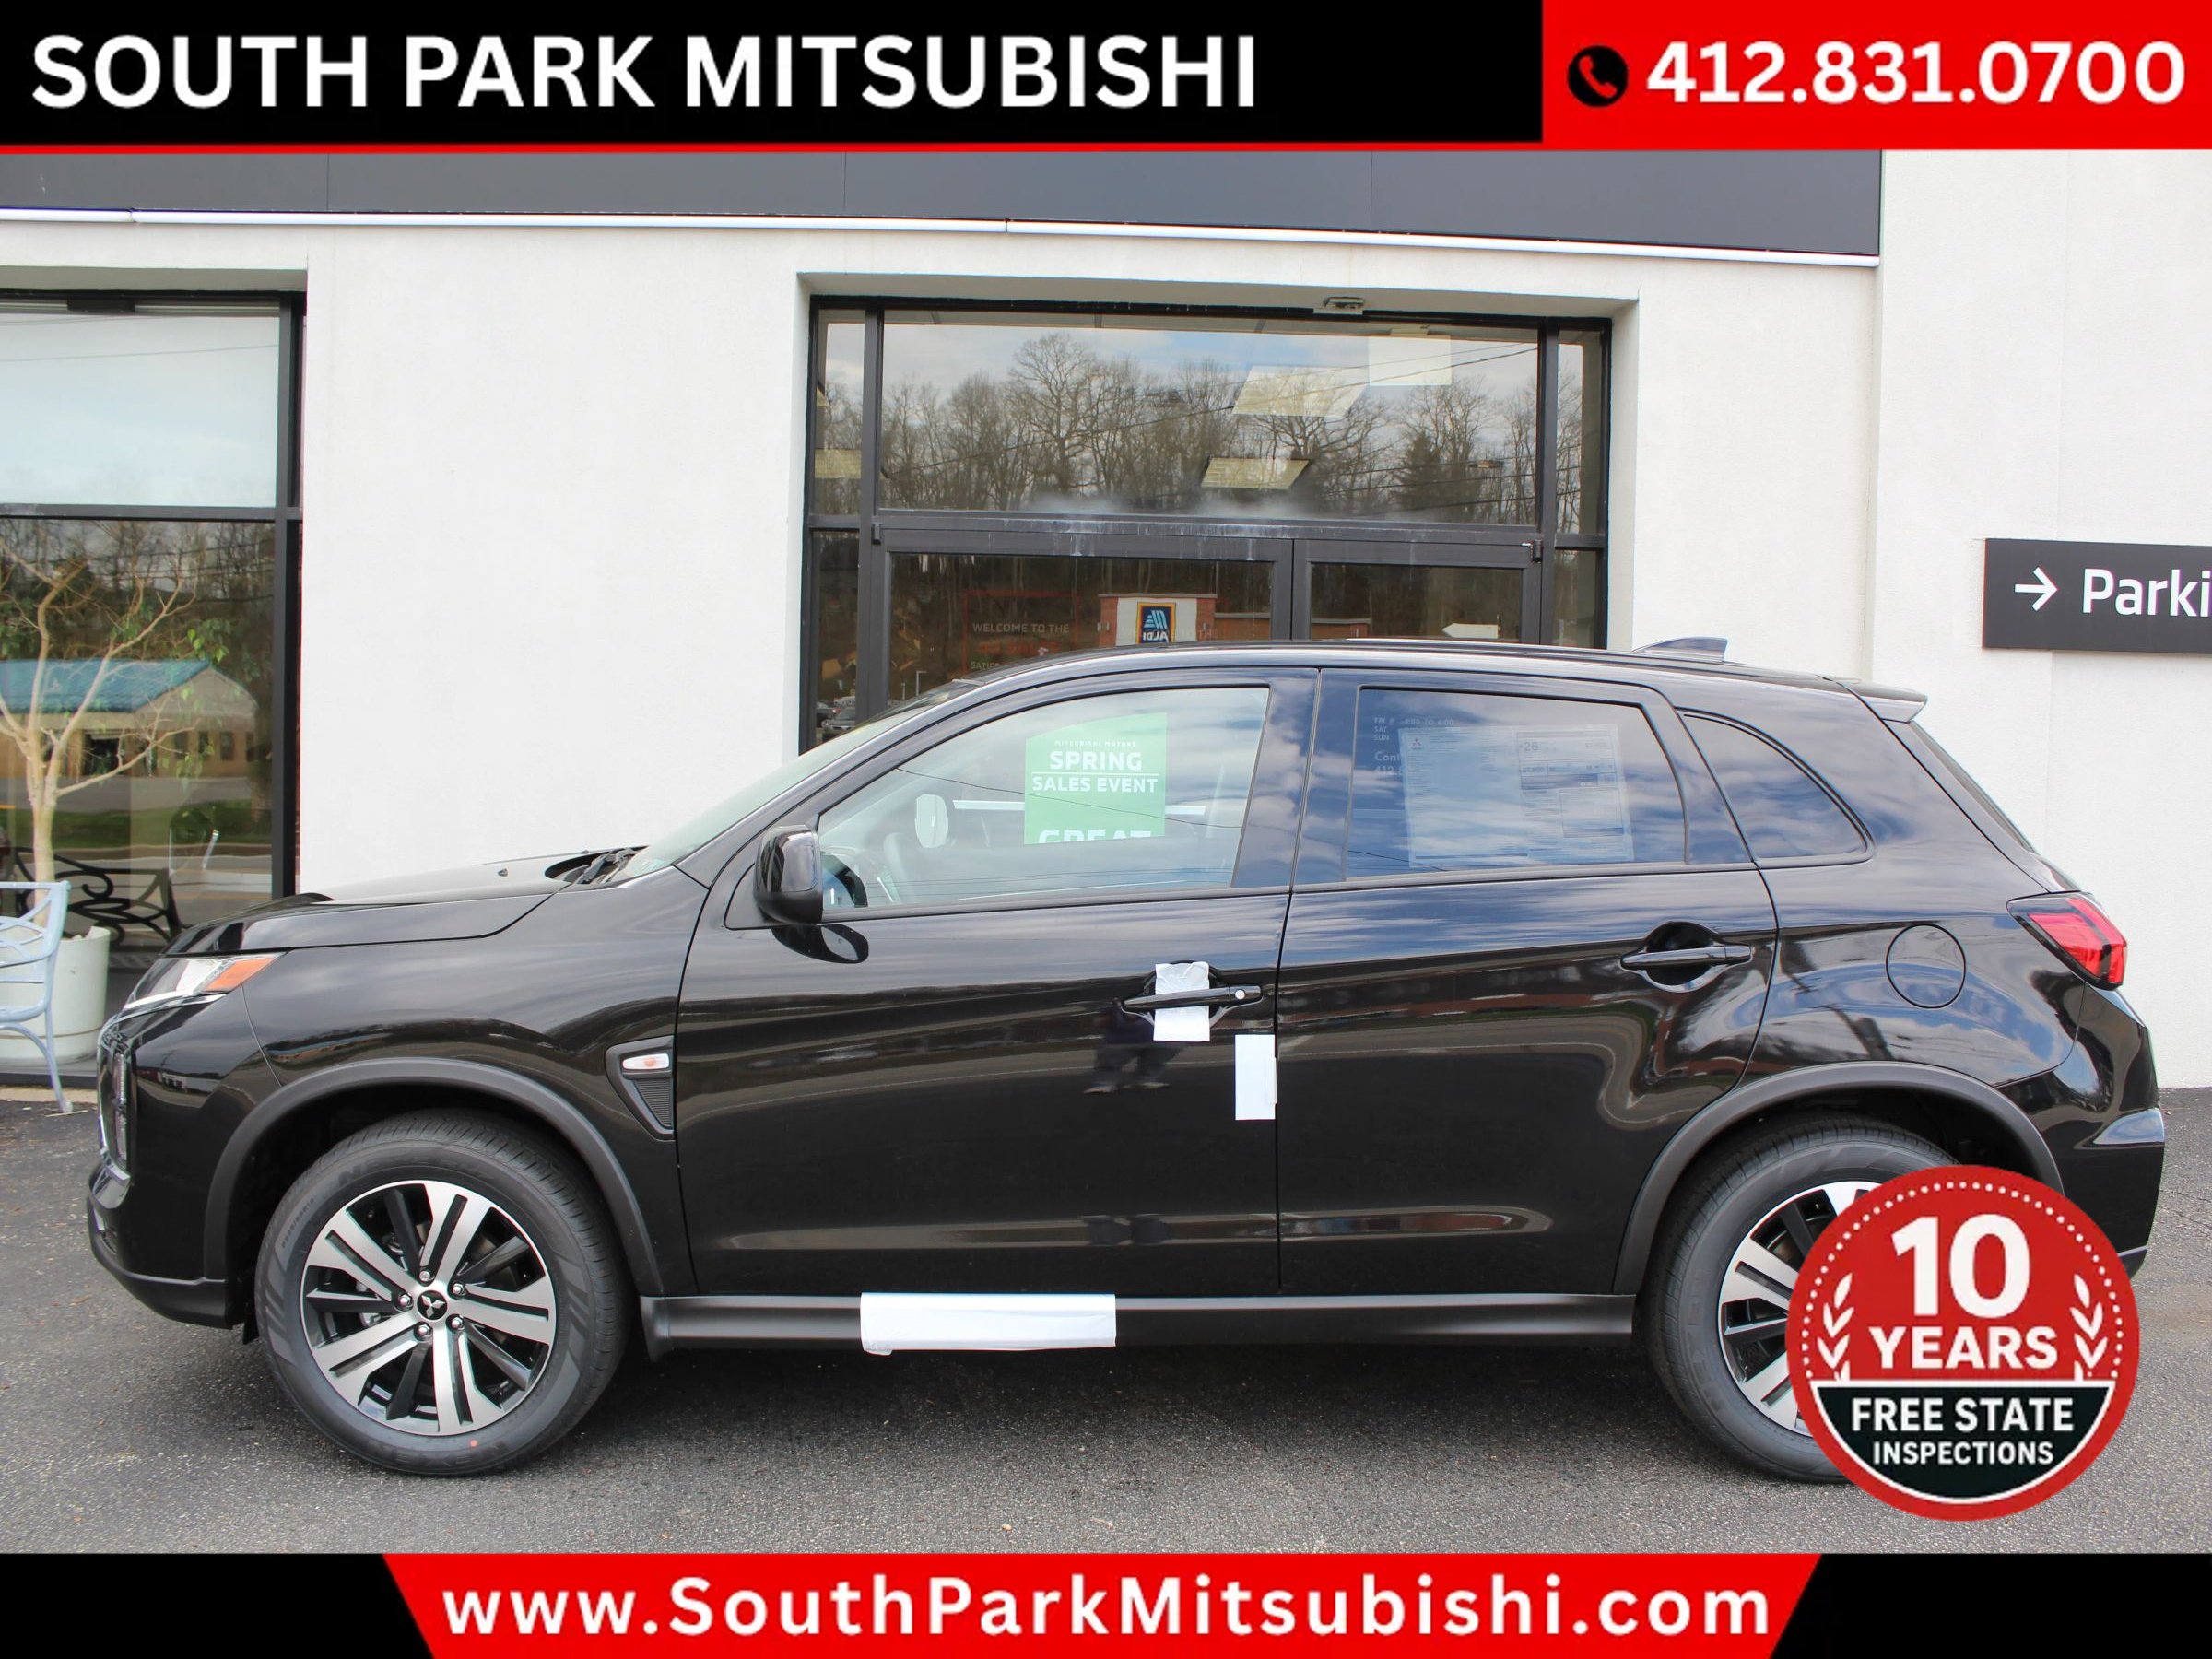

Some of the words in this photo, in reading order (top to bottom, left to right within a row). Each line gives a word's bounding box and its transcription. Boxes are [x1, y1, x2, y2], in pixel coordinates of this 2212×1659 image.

[972, 622, 1029, 634] WELCOME
[1030, 623, 1046, 634] TO
[1047, 623, 1070, 635] THE
[1050, 751, 1142, 771] SPRING
[1031, 777, 1091, 792] SALES
[1097, 778, 1159, 793] EVENT
